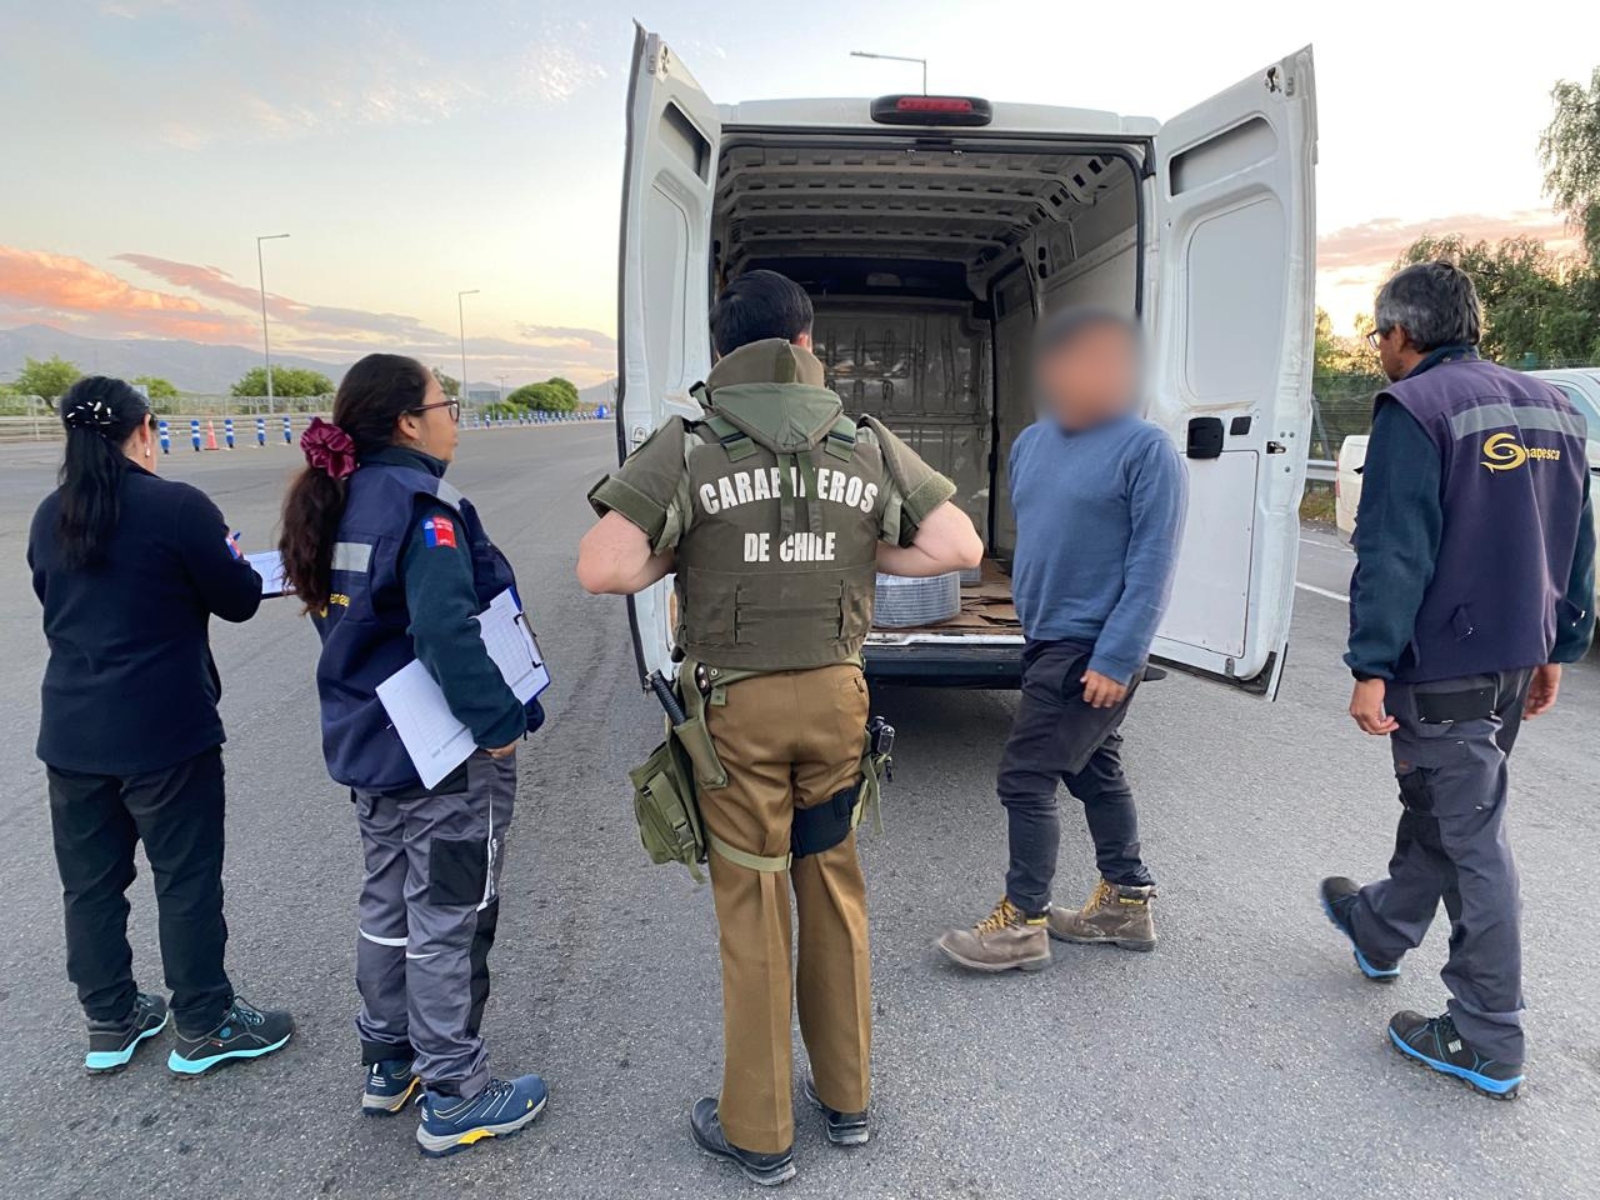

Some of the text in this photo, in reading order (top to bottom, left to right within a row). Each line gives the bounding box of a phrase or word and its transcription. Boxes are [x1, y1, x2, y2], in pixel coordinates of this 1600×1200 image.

[699, 466, 879, 515] CARABIEROS
[743, 531, 837, 563] DE CHILE
